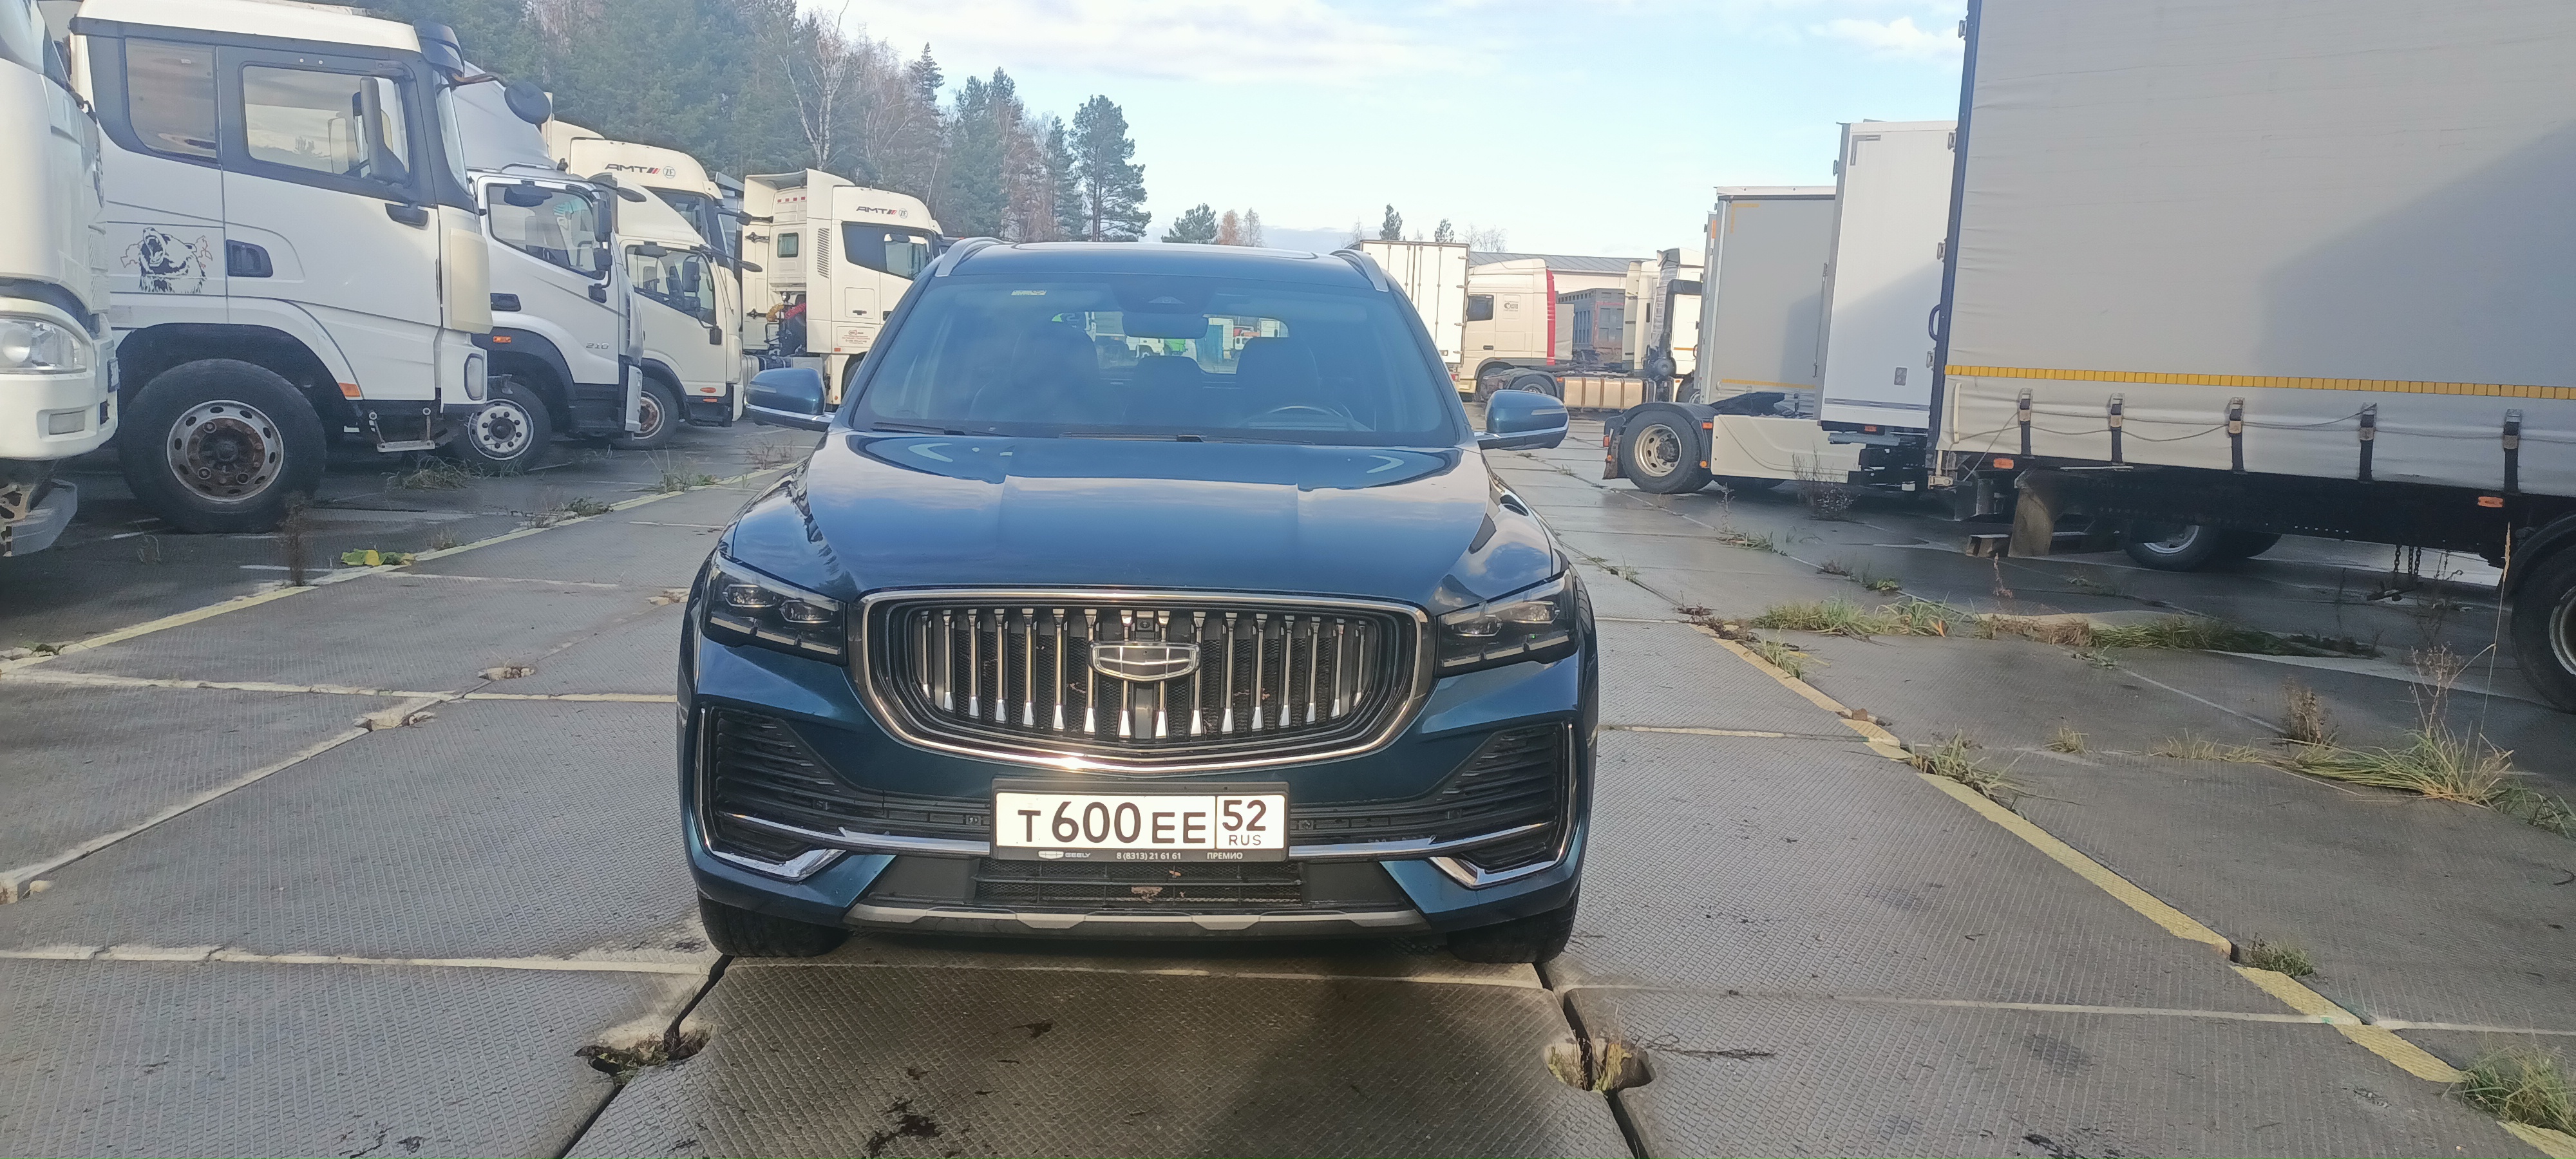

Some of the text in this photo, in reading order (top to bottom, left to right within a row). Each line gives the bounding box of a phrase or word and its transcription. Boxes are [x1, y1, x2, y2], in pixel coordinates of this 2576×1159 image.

[663, 167, 675, 178] ZF
[1222, 800, 1267, 831] 52
[1229, 834, 1262, 846] RUS
